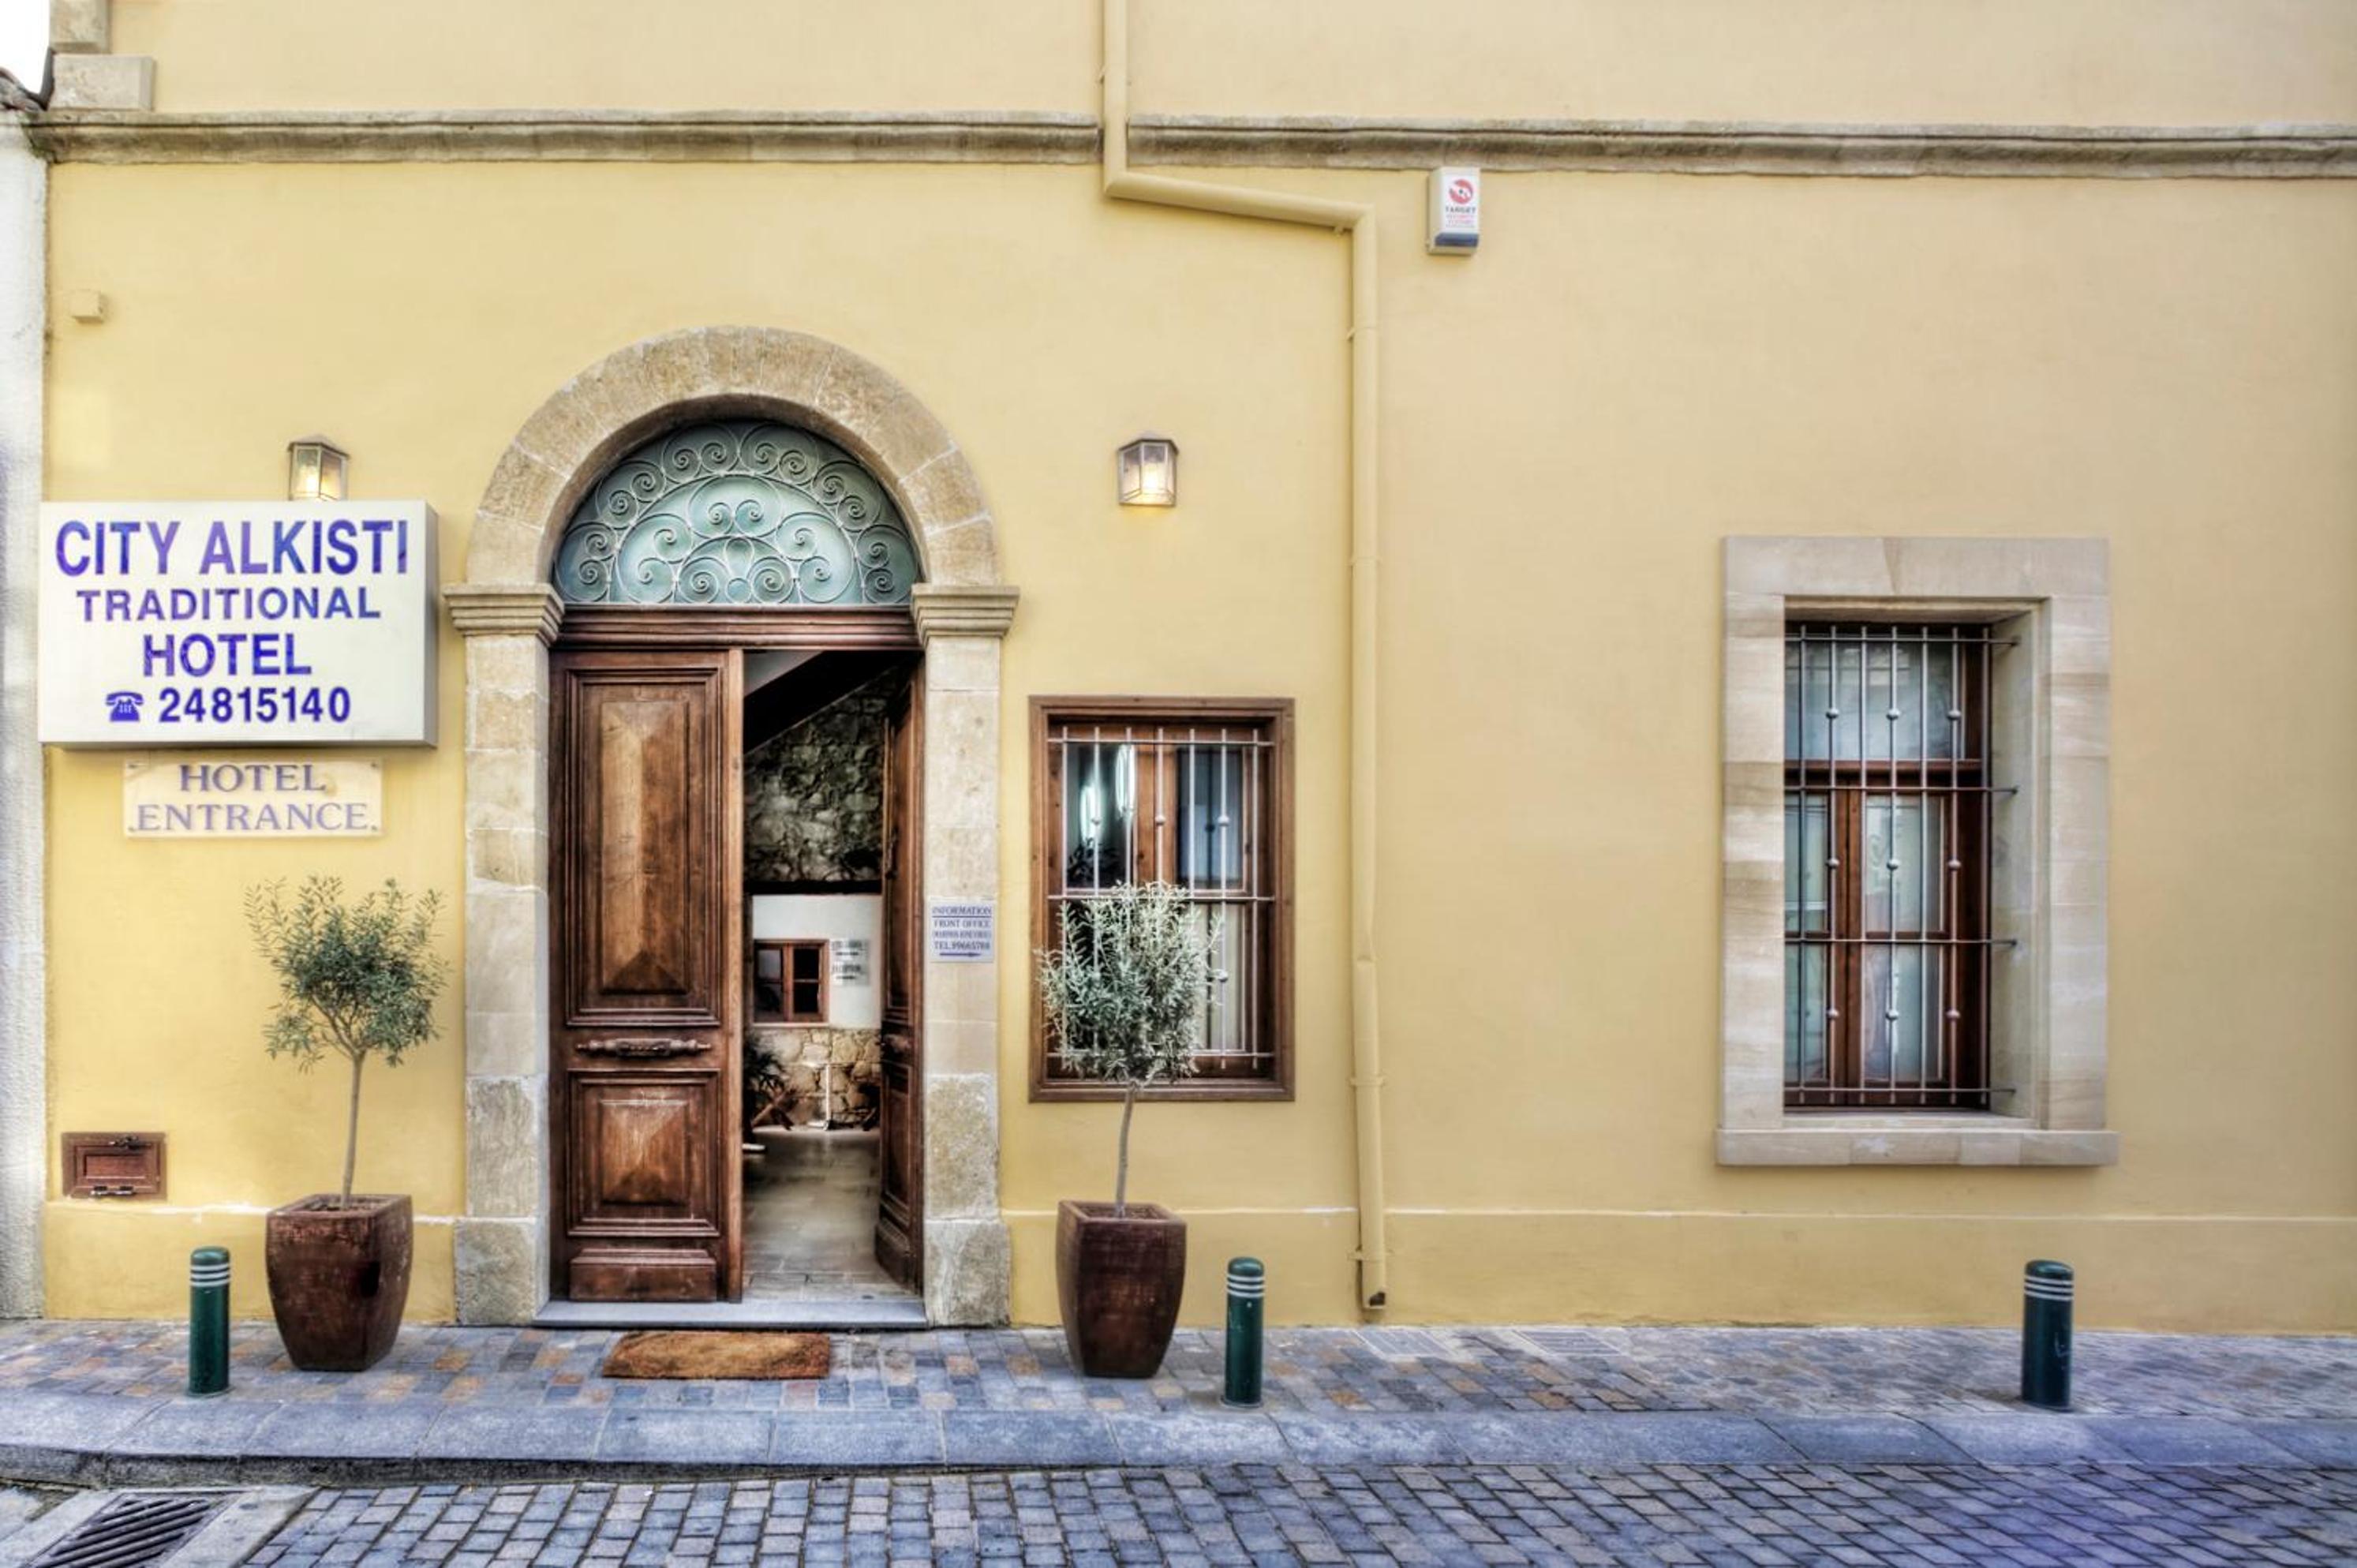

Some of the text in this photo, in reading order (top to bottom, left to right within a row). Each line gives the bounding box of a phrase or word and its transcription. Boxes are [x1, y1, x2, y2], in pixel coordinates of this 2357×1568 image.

[55, 519, 408, 577] CITY ALKISTI
[76, 586, 381, 622] TRADITIONAL
[143, 633, 312, 677] HOTEL
[159, 686, 351, 724] 24815140
[178, 764, 327, 792] HOTEL
[137, 803, 369, 831] ENTRANCE
[931, 905, 992, 915] INFORMATION
[933, 919, 990, 928] FRONT OFFICE
